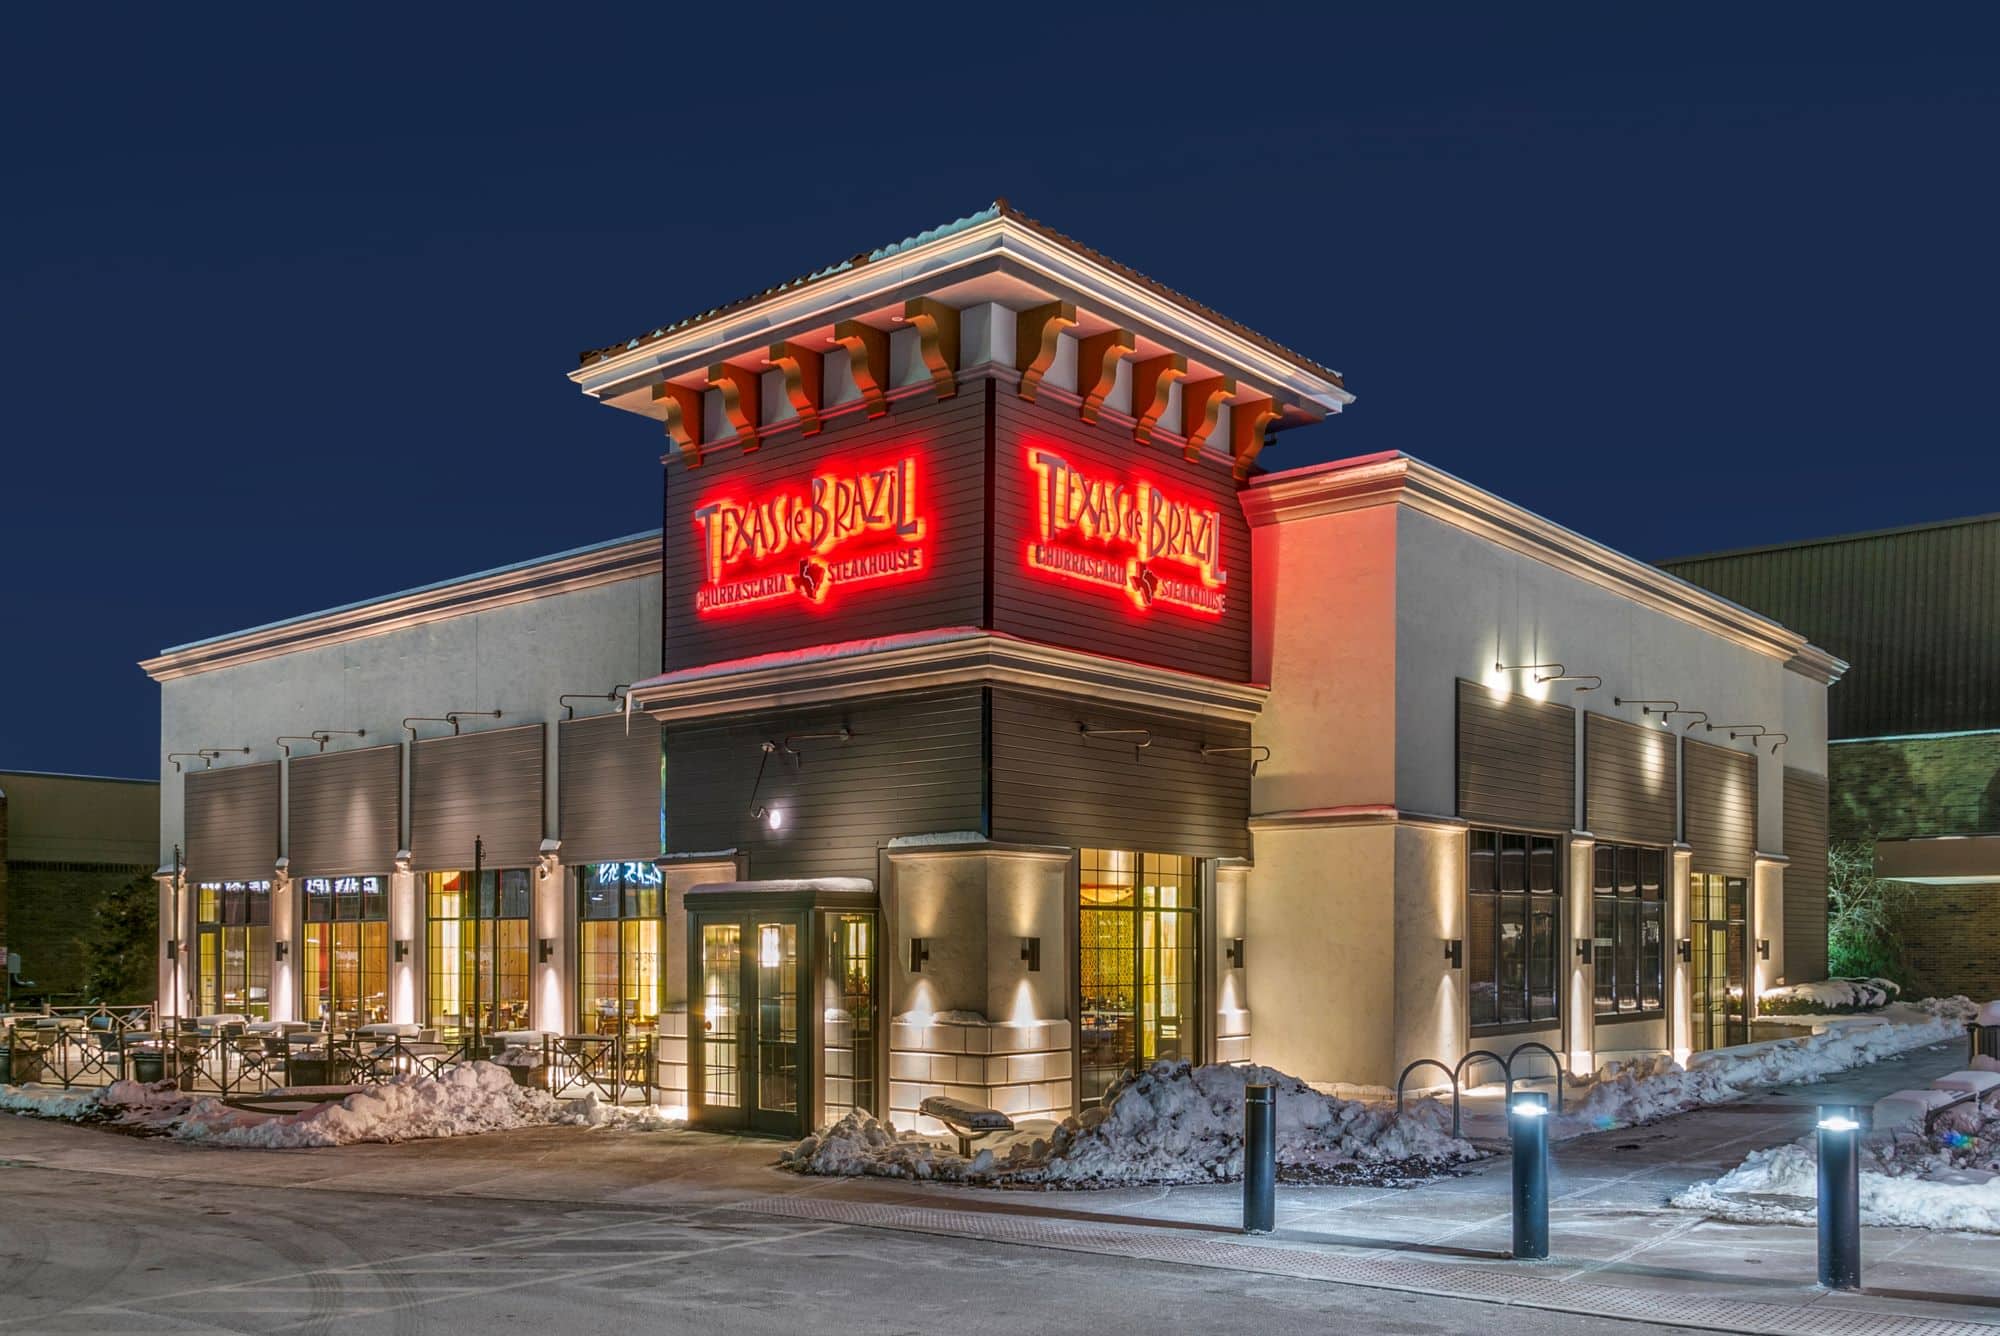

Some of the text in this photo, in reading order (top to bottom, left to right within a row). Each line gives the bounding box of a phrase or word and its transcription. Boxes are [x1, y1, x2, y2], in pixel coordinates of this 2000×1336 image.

[695, 494, 786, 588] TEXAS
[810, 459, 920, 551] BRAZIL
[1034, 451, 1125, 540] TEXAS
[1147, 487, 1227, 584] BRAZIL
[696, 547, 921, 610] CHURRASCARIA STEAKHOUSE
[1035, 544, 1226, 613] CHURRASCARIA STEAKHOUSE
